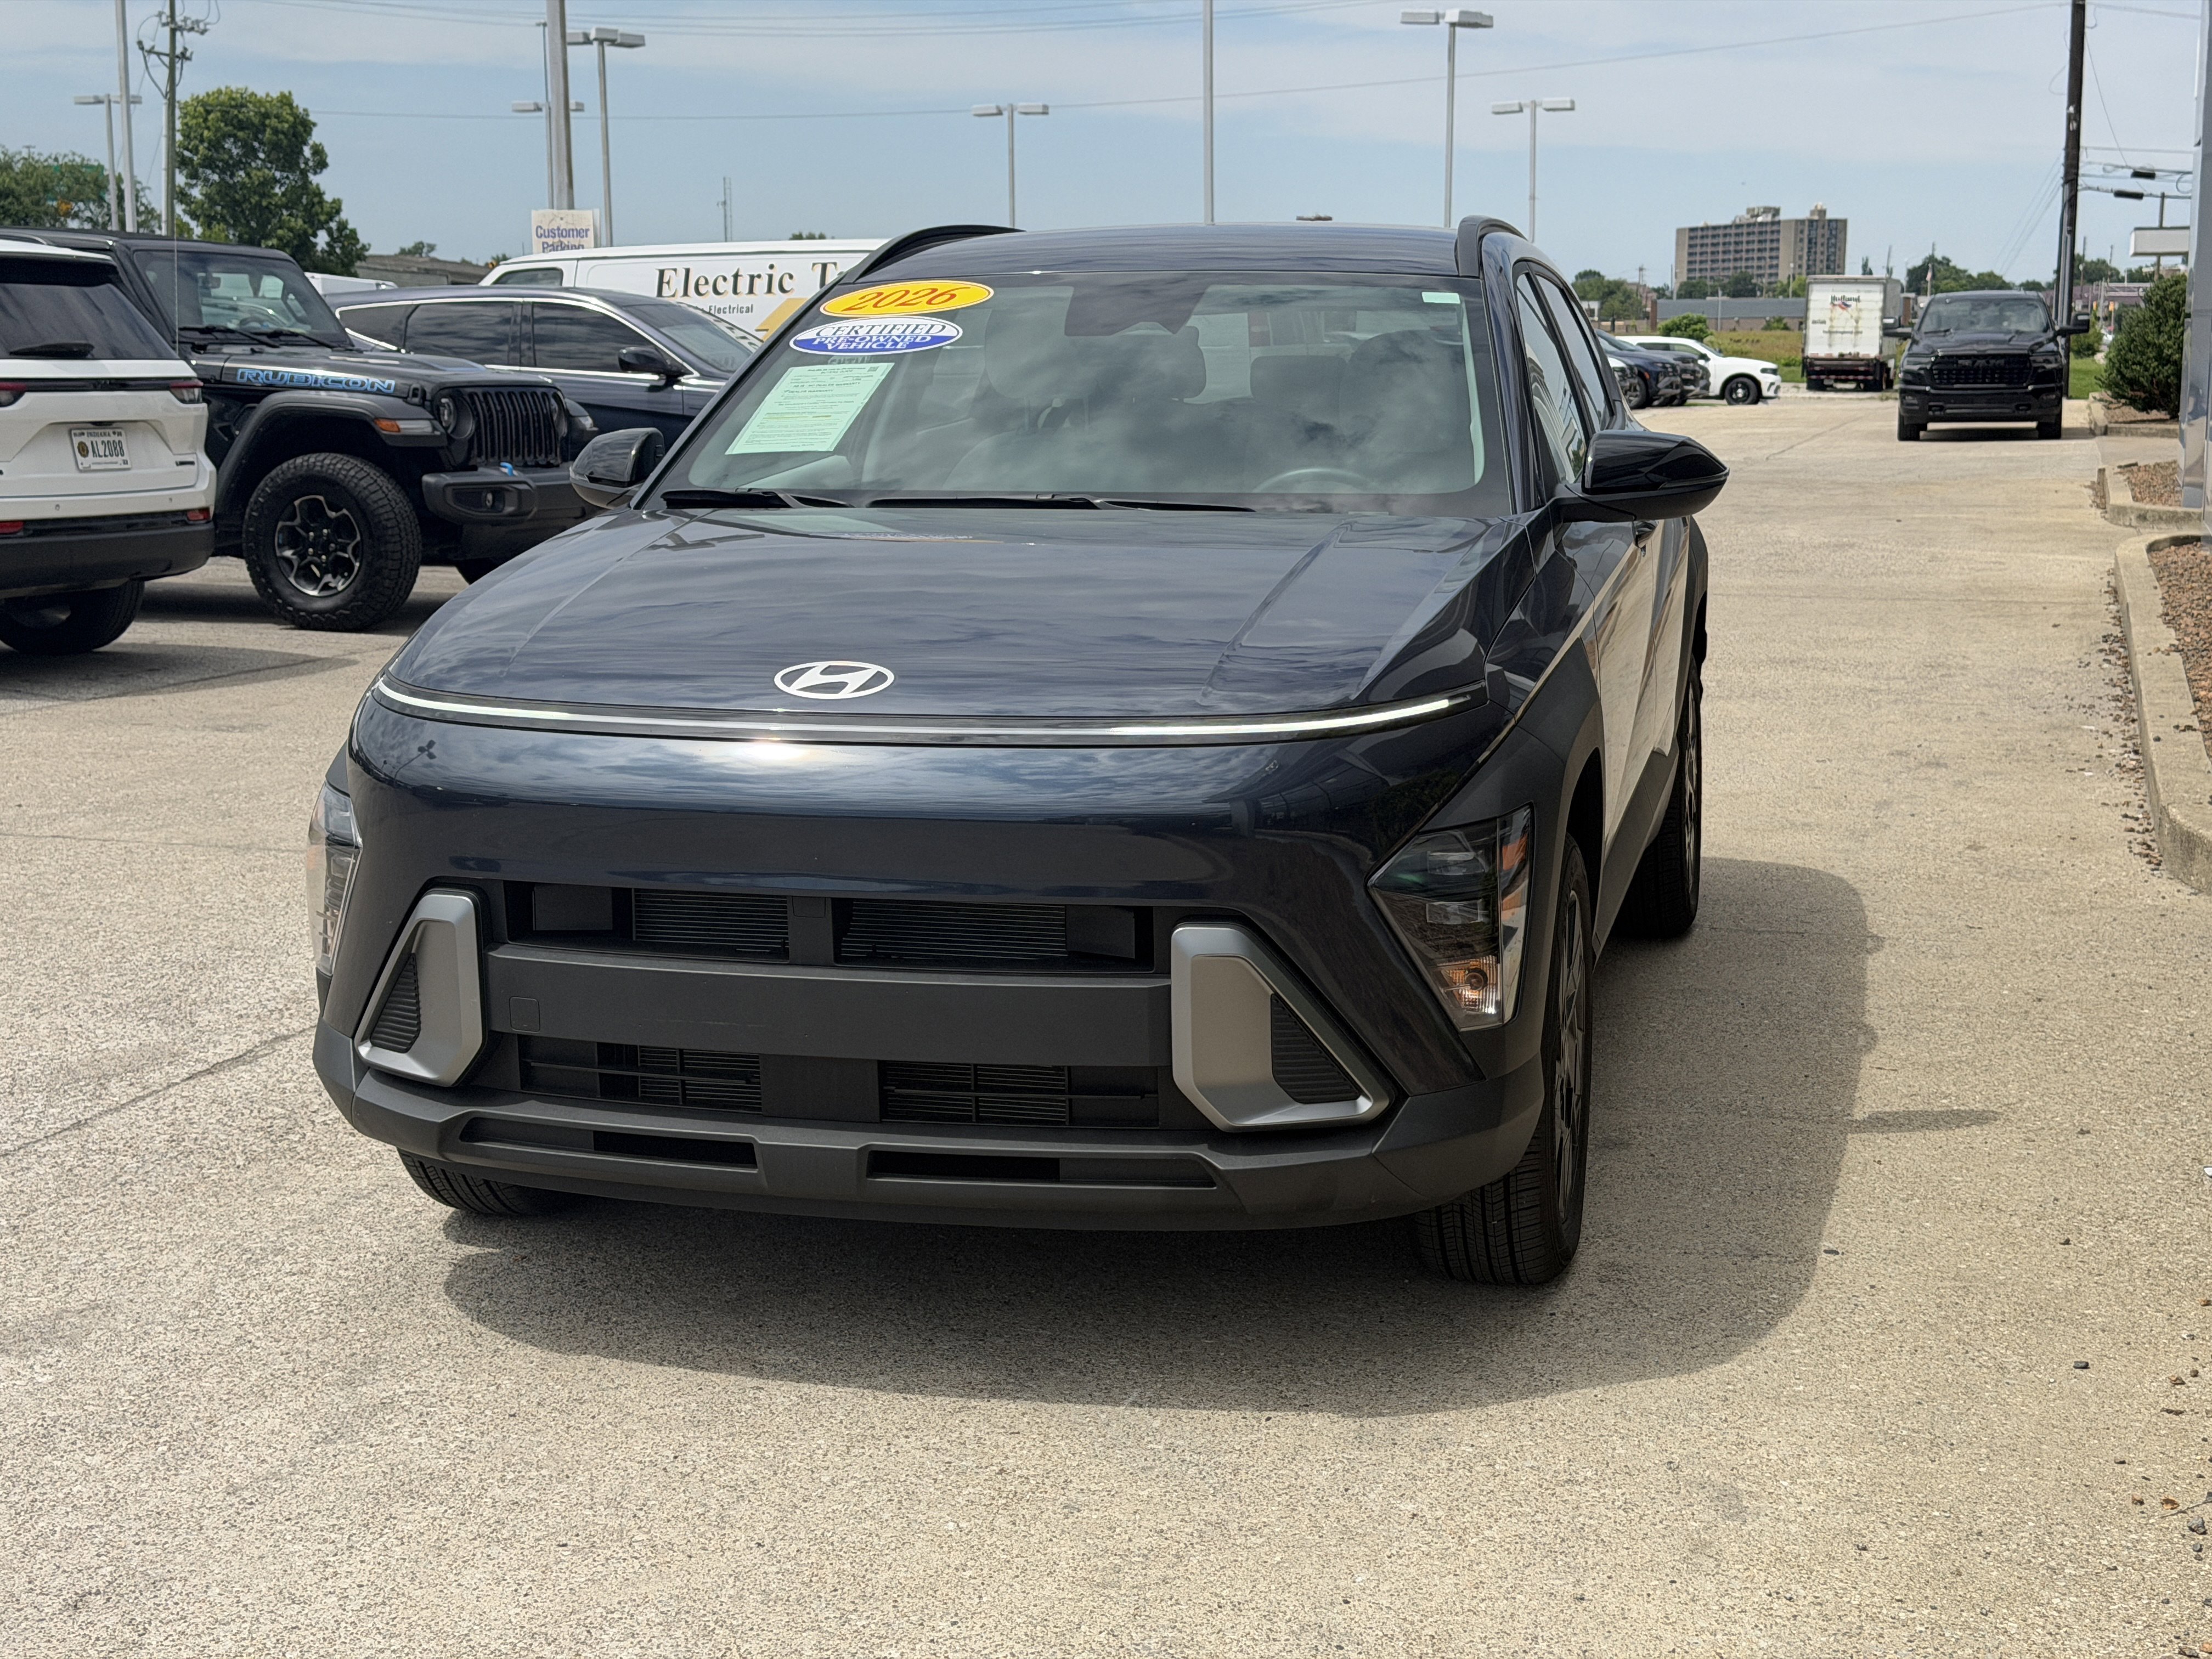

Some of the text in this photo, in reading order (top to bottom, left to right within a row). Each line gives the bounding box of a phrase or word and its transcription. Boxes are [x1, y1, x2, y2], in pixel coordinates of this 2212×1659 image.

[535, 225, 590, 238] Customer
[655, 262, 844, 298] Electric T
[840, 286, 971, 312] 2026
[708, 303, 754, 314] Electrical
[815, 323, 946, 337] CERTIFIED
[811, 335, 932, 345] PRE-OWNED
[826, 341, 910, 351] VEHICLE
[236, 368, 396, 394] RUBICON
